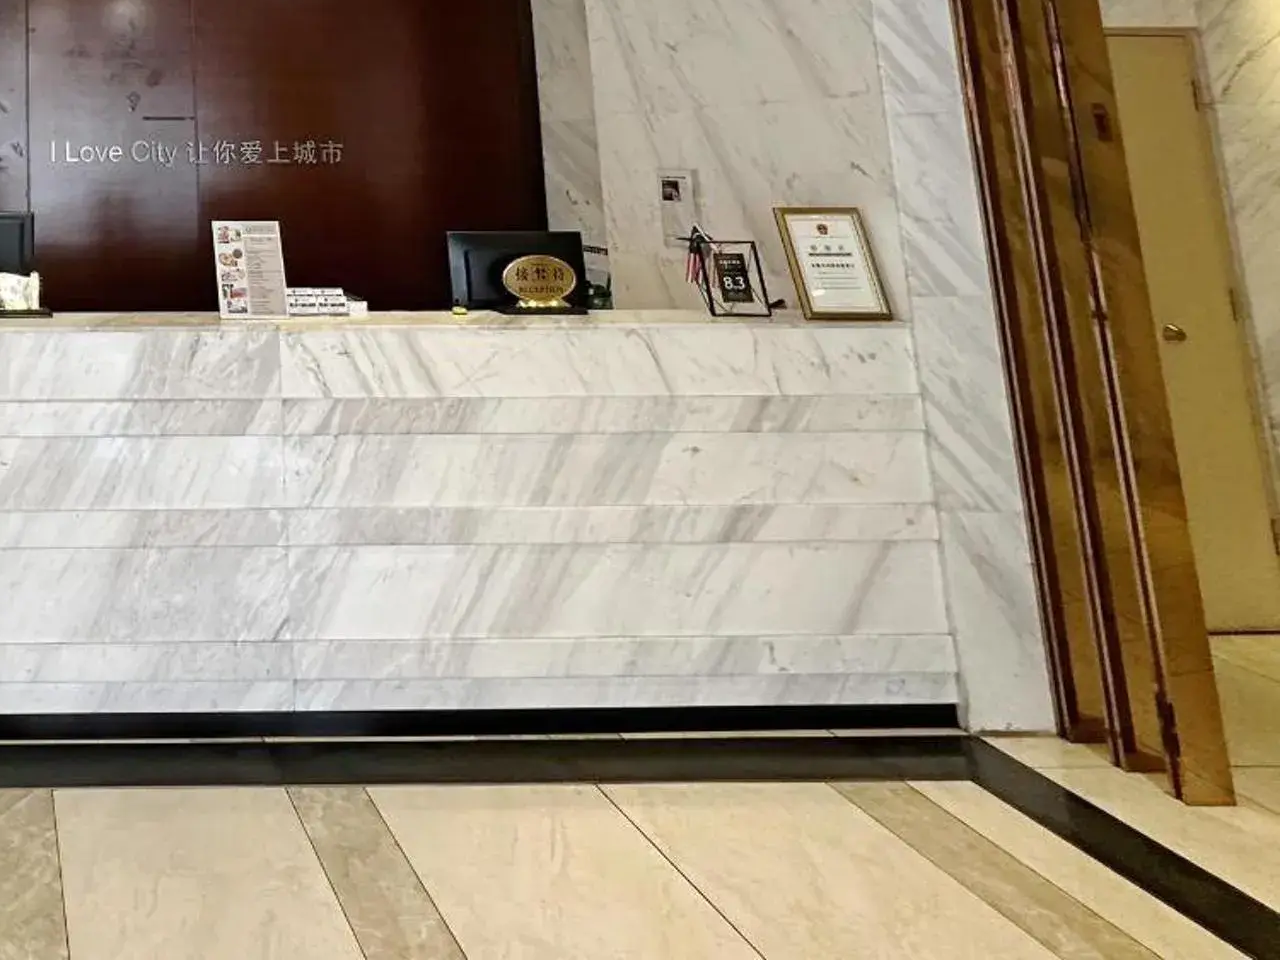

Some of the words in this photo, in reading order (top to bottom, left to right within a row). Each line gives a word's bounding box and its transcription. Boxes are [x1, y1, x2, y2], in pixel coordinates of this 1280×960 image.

[50, 140, 56, 162] I
[65, 140, 123, 162] Love
[131, 140, 178, 168] City
[186, 140, 345, 165] 让你爱上城市
